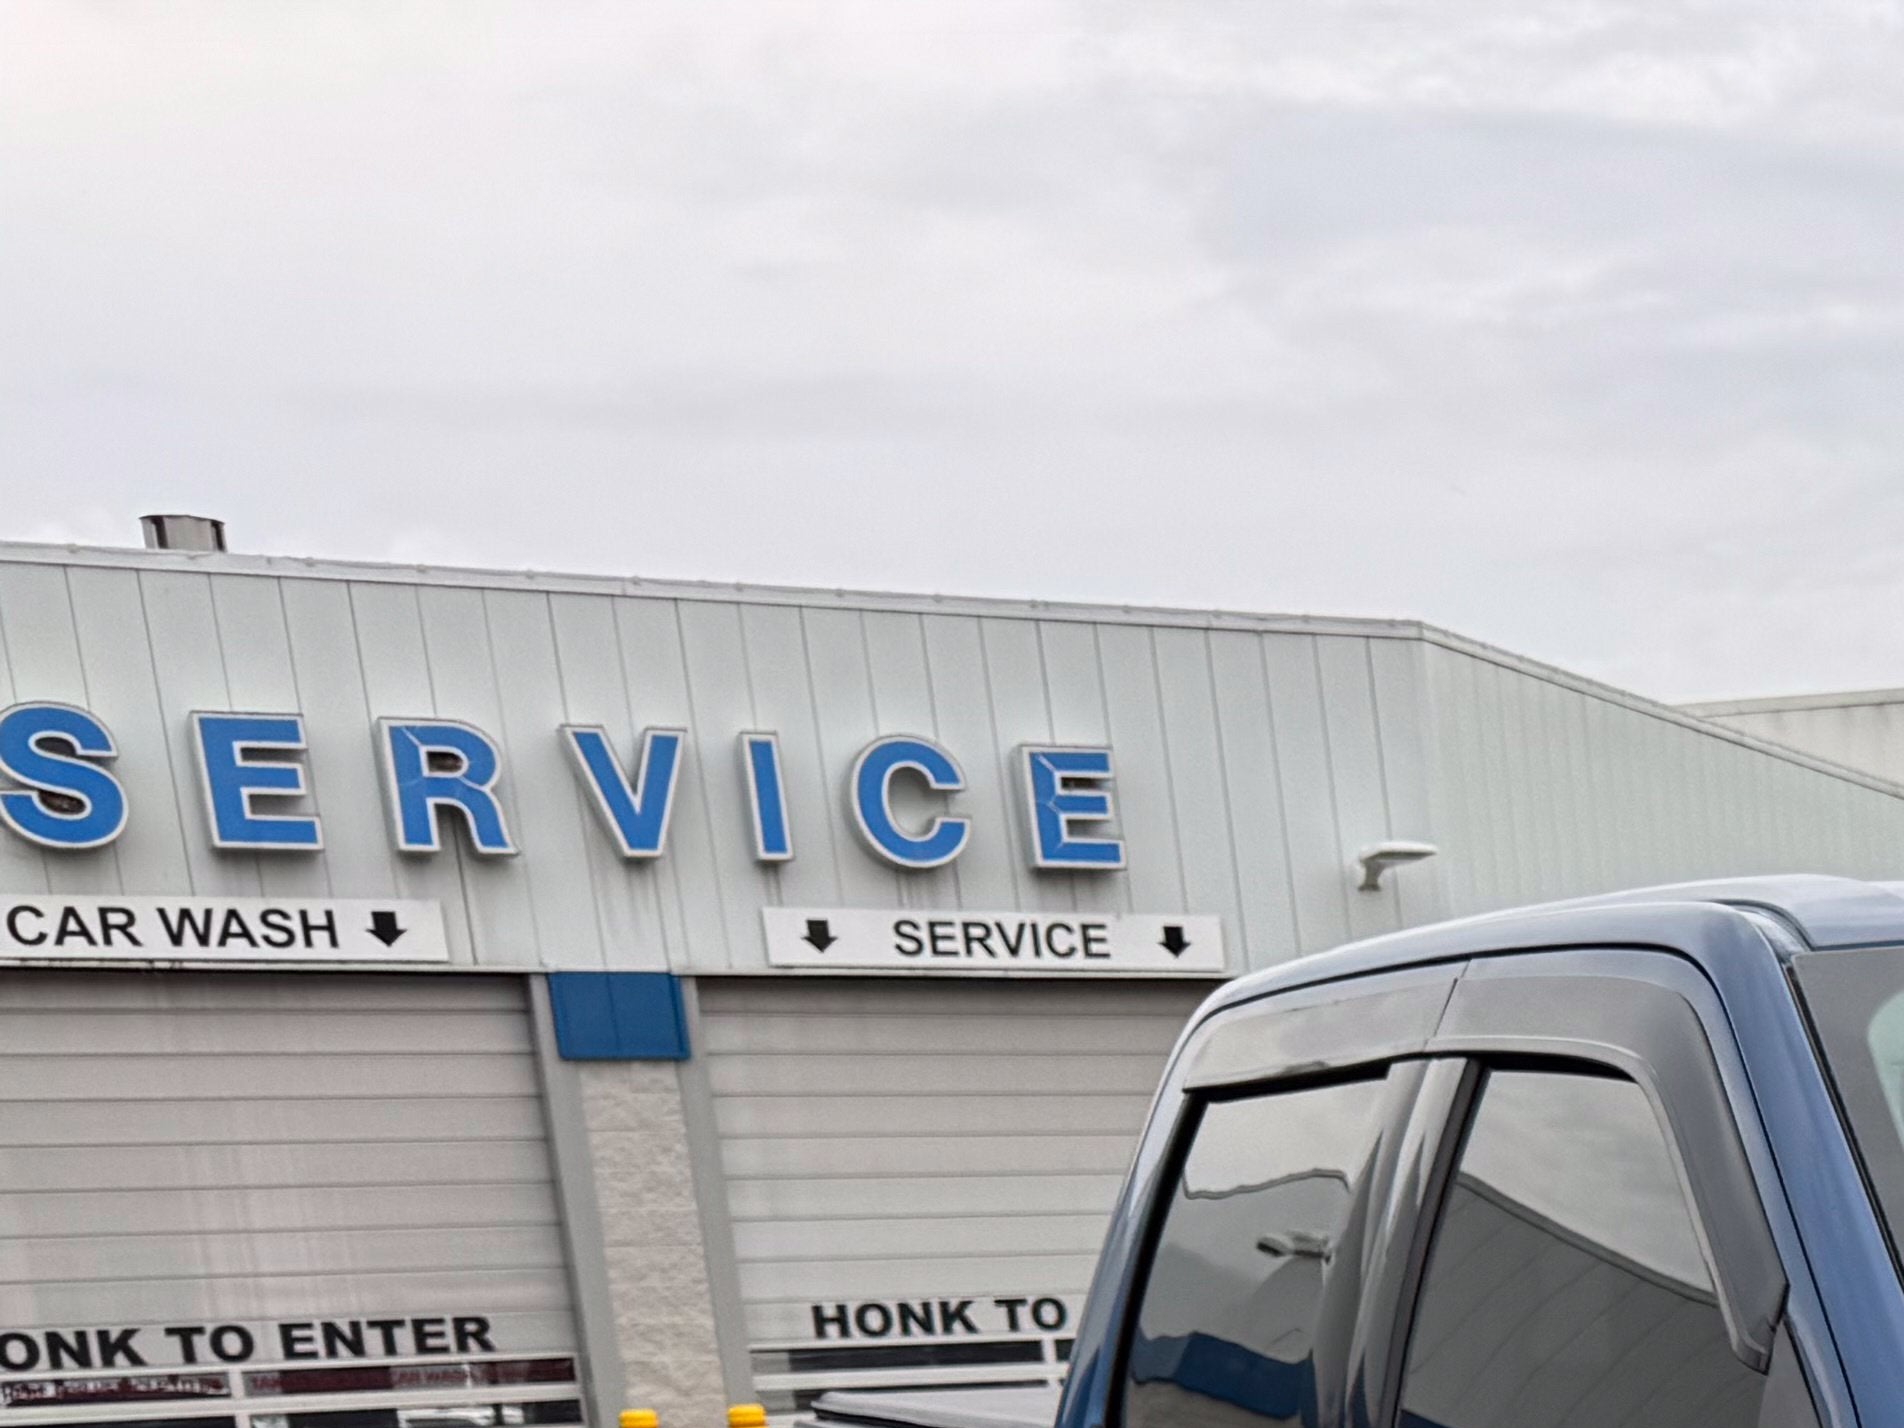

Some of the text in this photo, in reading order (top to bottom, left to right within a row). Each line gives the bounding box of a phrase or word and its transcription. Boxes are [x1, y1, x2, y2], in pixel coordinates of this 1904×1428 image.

[0, 700, 1128, 871] SERVICE
[6, 904, 341, 949] CAR WASH
[892, 918, 1112, 960] SERVICE
[164, 1323, 255, 1365] TO
[278, 1315, 497, 1362] ENTER
[811, 1297, 1068, 1339] HONK TO
